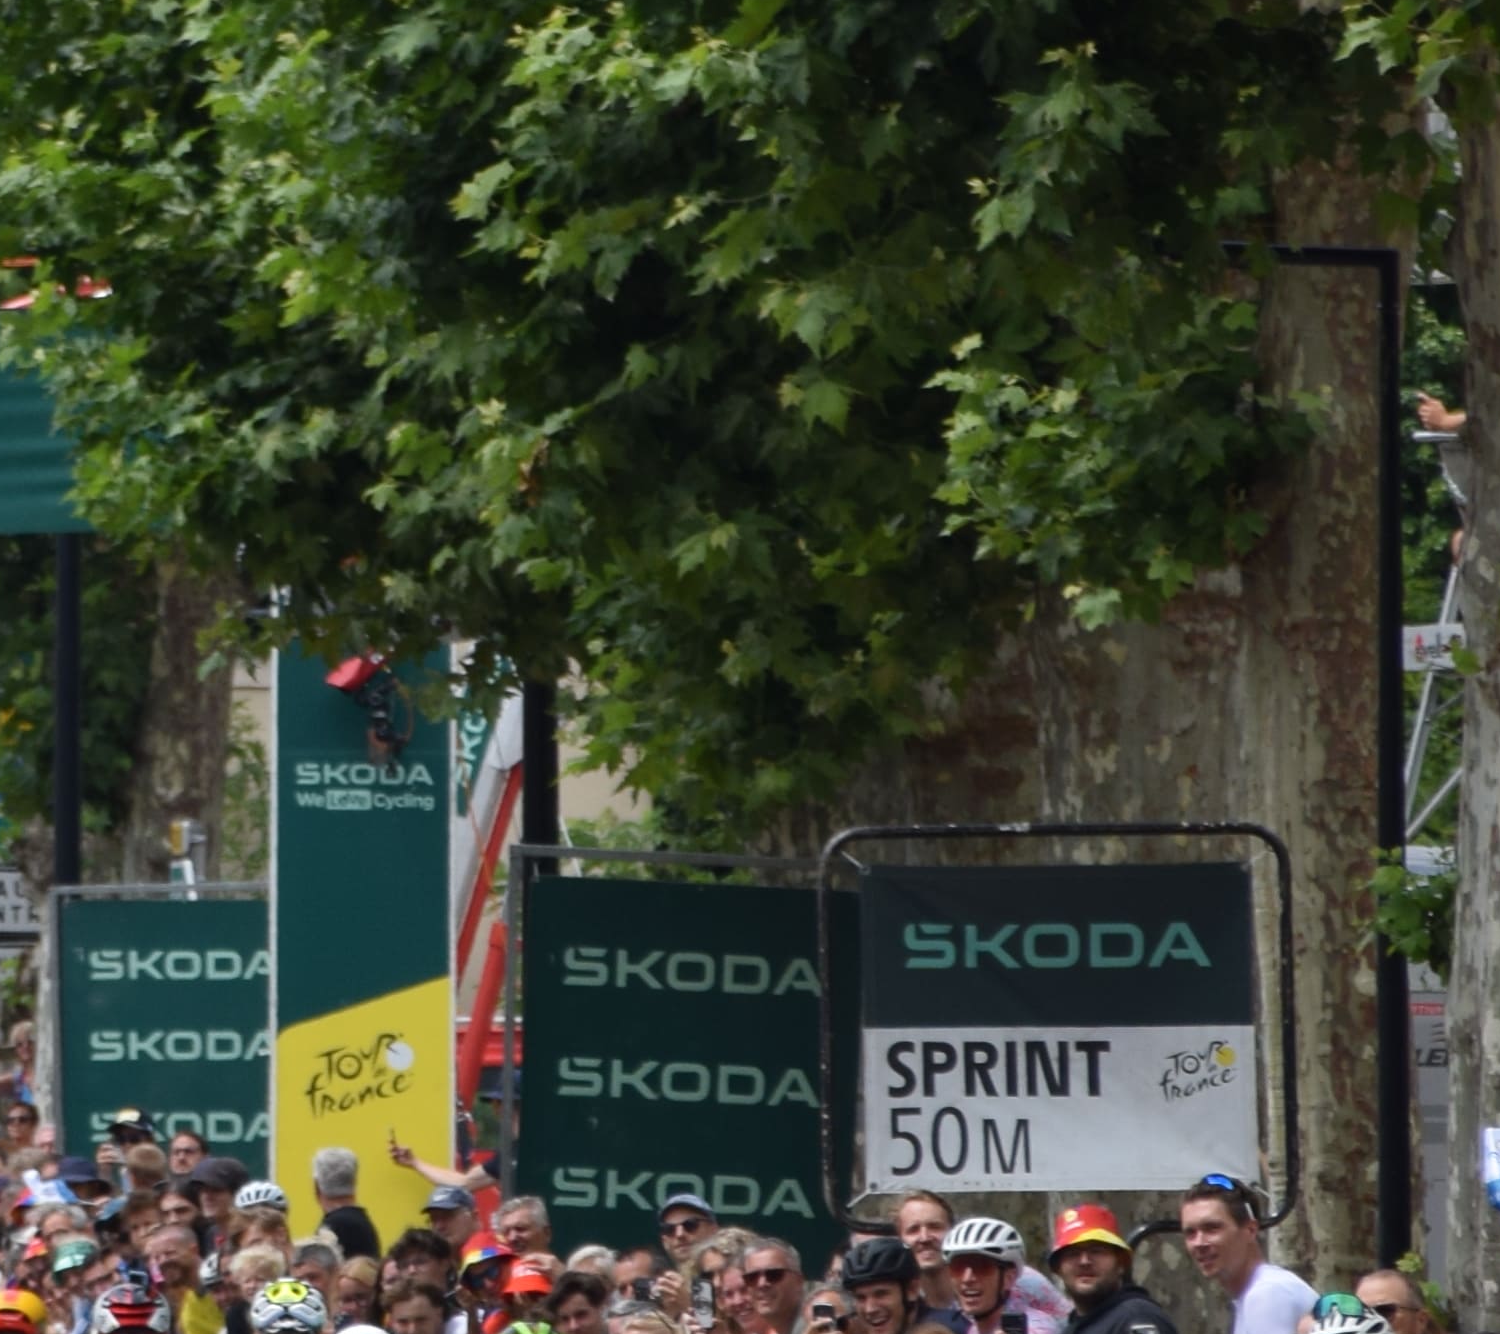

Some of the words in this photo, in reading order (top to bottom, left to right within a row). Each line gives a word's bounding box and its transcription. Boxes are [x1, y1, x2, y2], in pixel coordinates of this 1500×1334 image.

[296, 792, 326, 809] We
[373, 791, 436, 811] Cycling
[885, 1039, 1112, 1099] SPRINT
